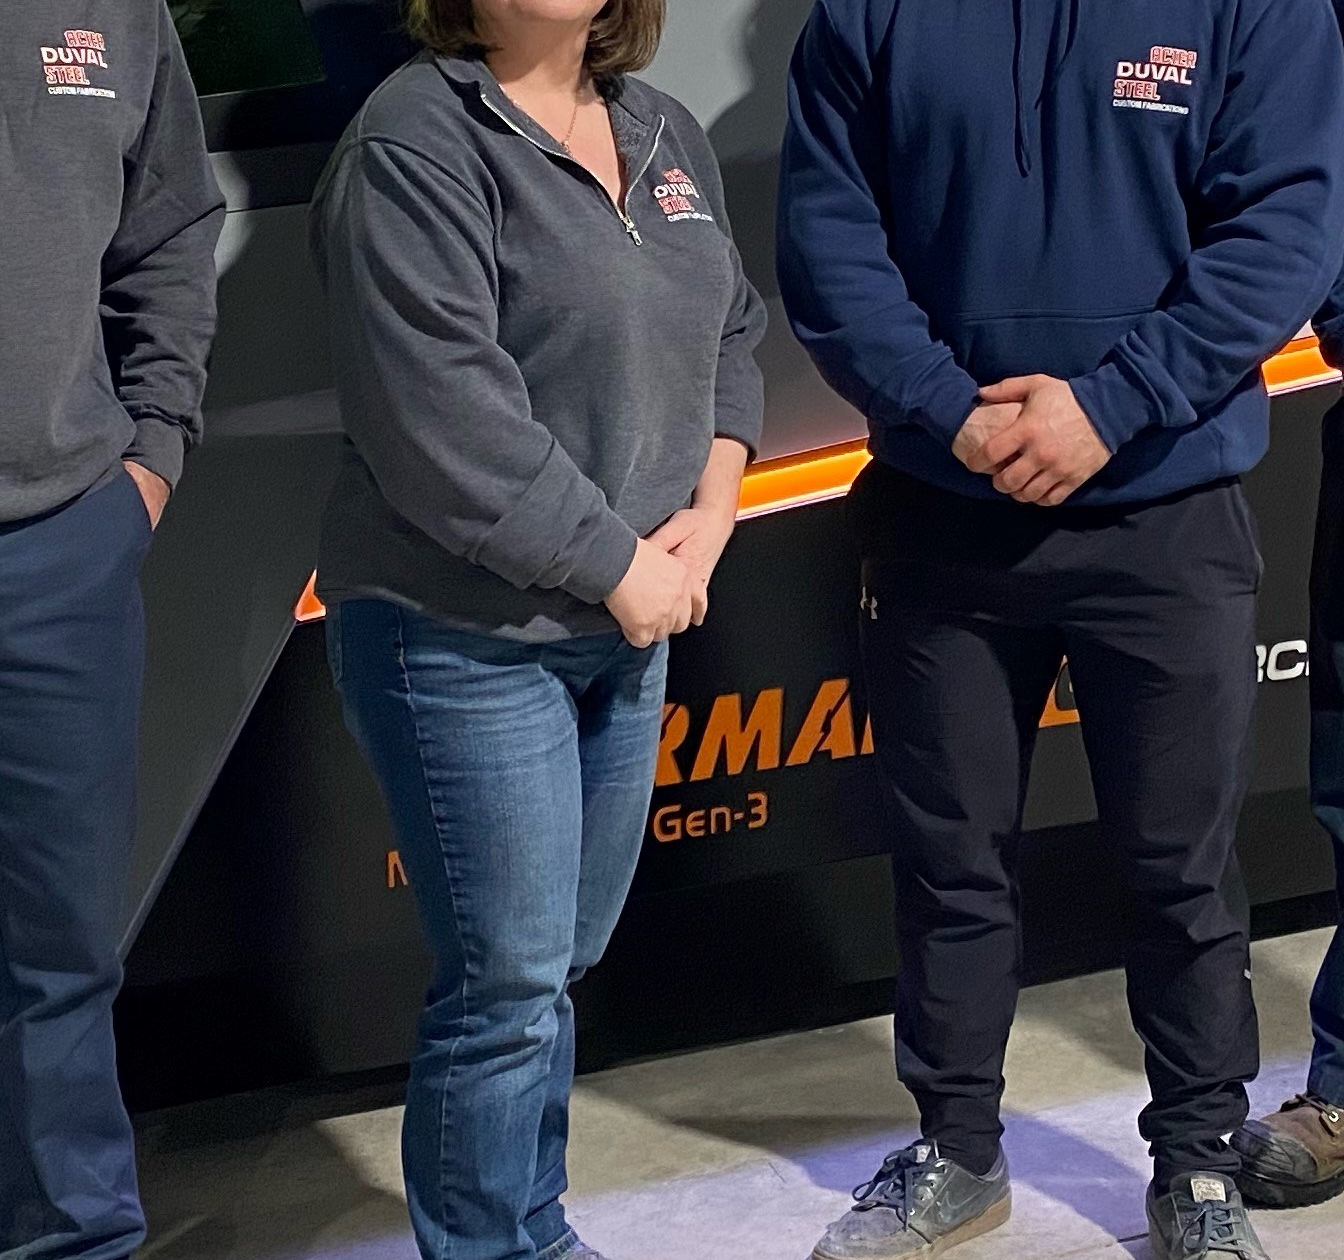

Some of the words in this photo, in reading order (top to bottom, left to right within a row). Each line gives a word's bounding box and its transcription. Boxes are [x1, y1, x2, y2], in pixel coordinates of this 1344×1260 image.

[40, 46, 108, 68] DUVAL
[1150, 46, 1198, 68] ACIER
[44, 66, 90, 86] STEEL
[1116, 62, 1192, 85] DUVAL
[1113, 79, 1161, 100] STEEL
[656, 678, 874, 786] RMA
[653, 791, 769, 842] Gen-3
